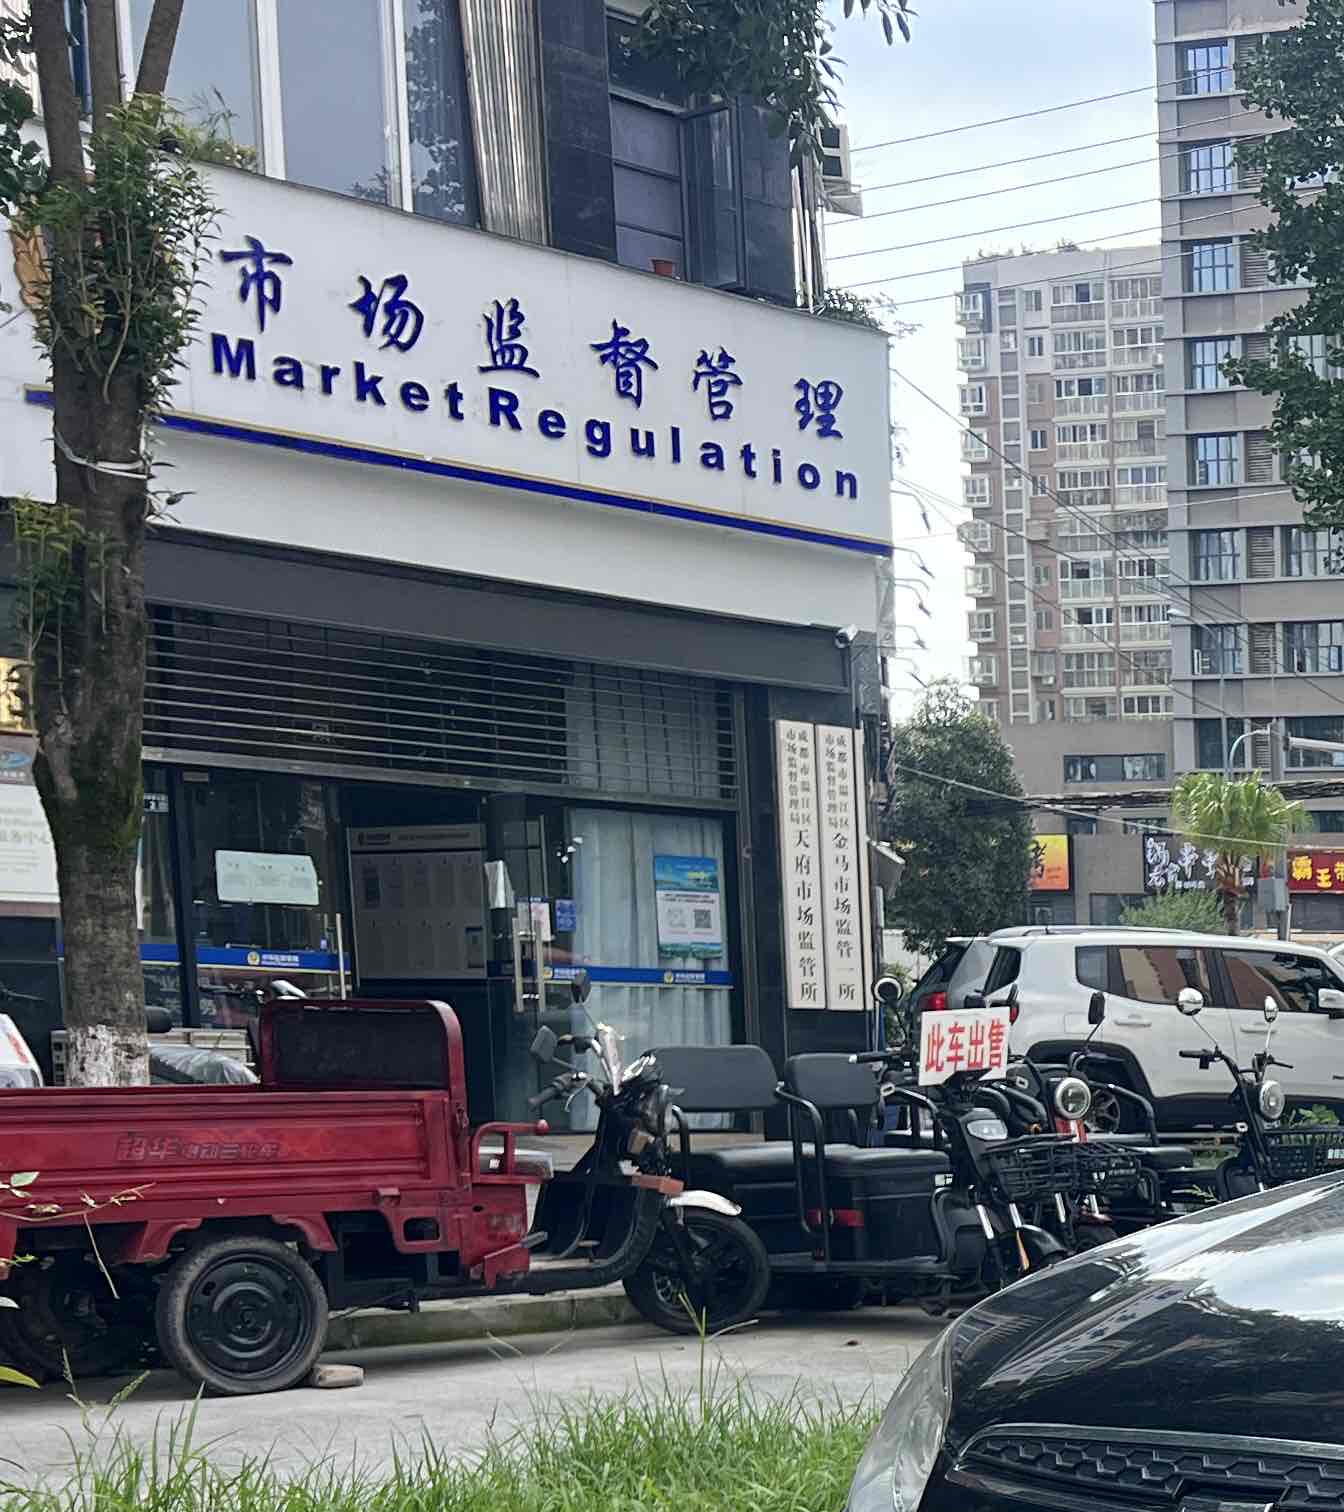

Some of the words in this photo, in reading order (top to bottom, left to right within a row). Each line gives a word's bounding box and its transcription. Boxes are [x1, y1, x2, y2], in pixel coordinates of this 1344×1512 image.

[219, 234, 845, 440] 市场监督管理
[794, 829, 817, 1002] 天府市场监管所
[831, 832, 856, 1001] 金马市场监管一所
[925, 1018, 1005, 1073] 此车出售
